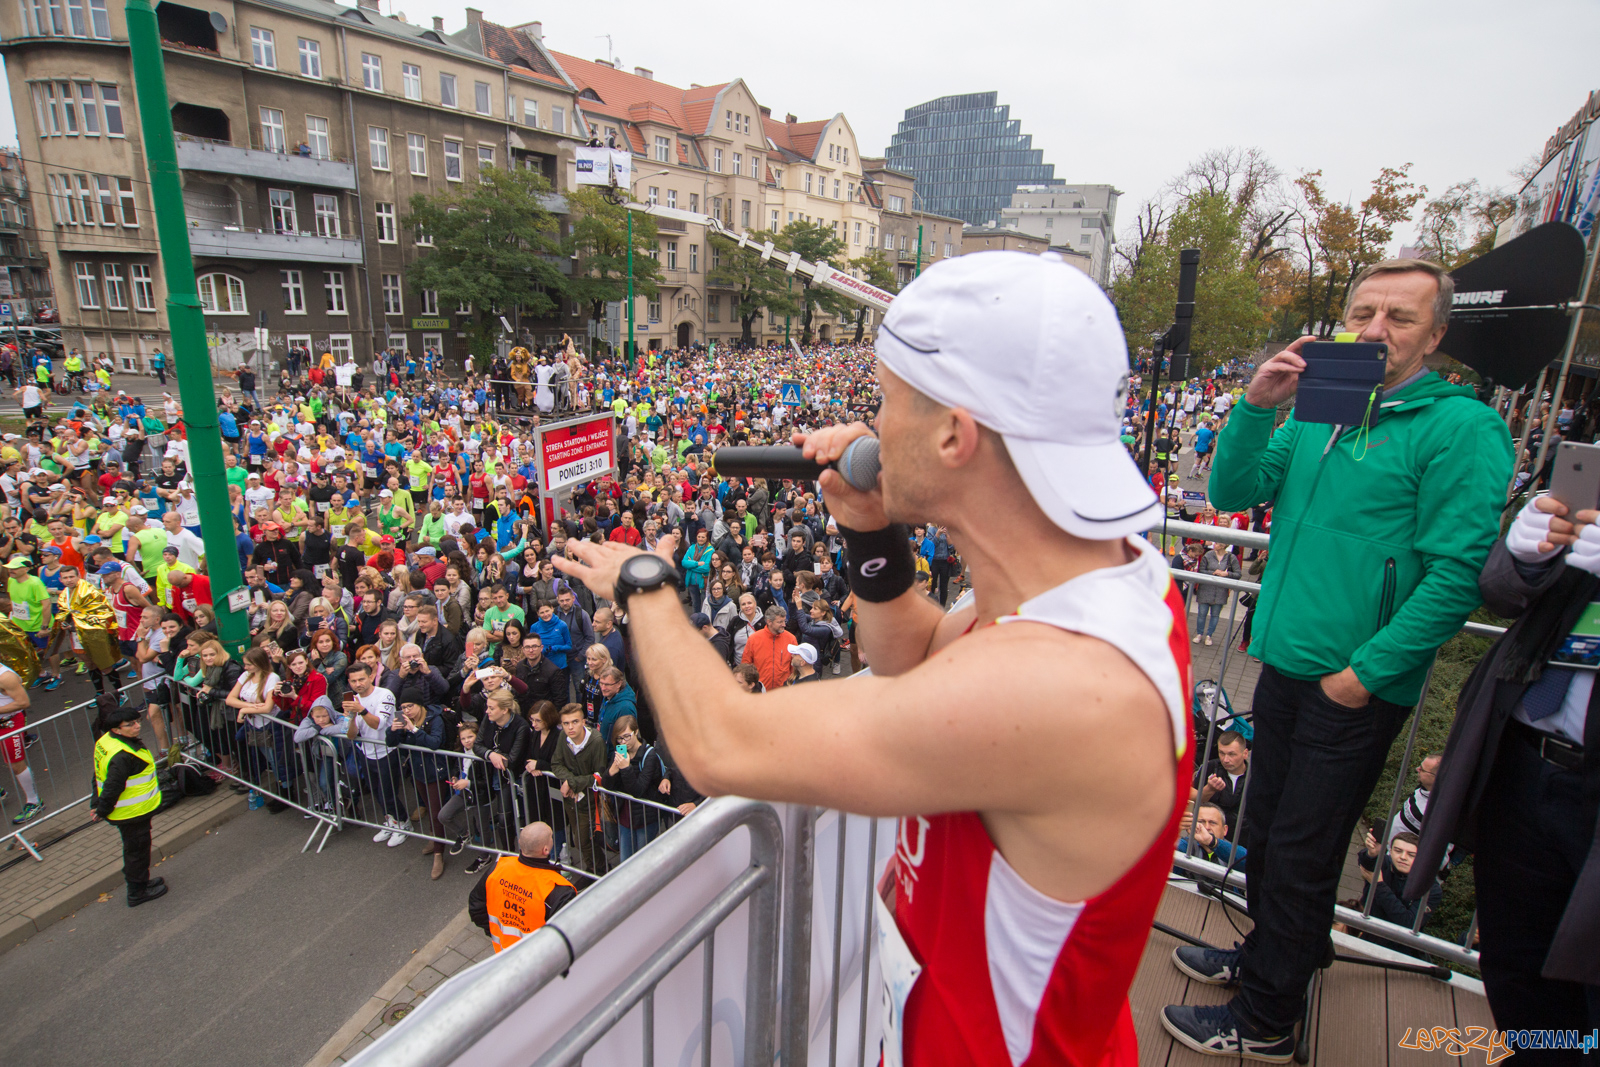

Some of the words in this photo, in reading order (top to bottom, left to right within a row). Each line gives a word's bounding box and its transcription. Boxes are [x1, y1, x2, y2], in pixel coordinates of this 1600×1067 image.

[1452, 290, 1504, 305] SHURE
[1, 305, 10, 314] P
[546, 443, 564, 453] STREFA
[564, 436, 587, 448] STARTOWA
[590, 430, 609, 440] WEJŚCIE
[548, 451, 571, 463] STARTING
[571, 446, 583, 456] ZONE
[586, 439, 608, 451] ENTRANCE
[559, 463, 587, 481] PONIŻEJ
[589, 458, 603, 471] 3:10
[500, 878, 533, 899] OCHRONA
[502, 888, 527, 904] VICTORY
[504, 900, 526, 917] 043
